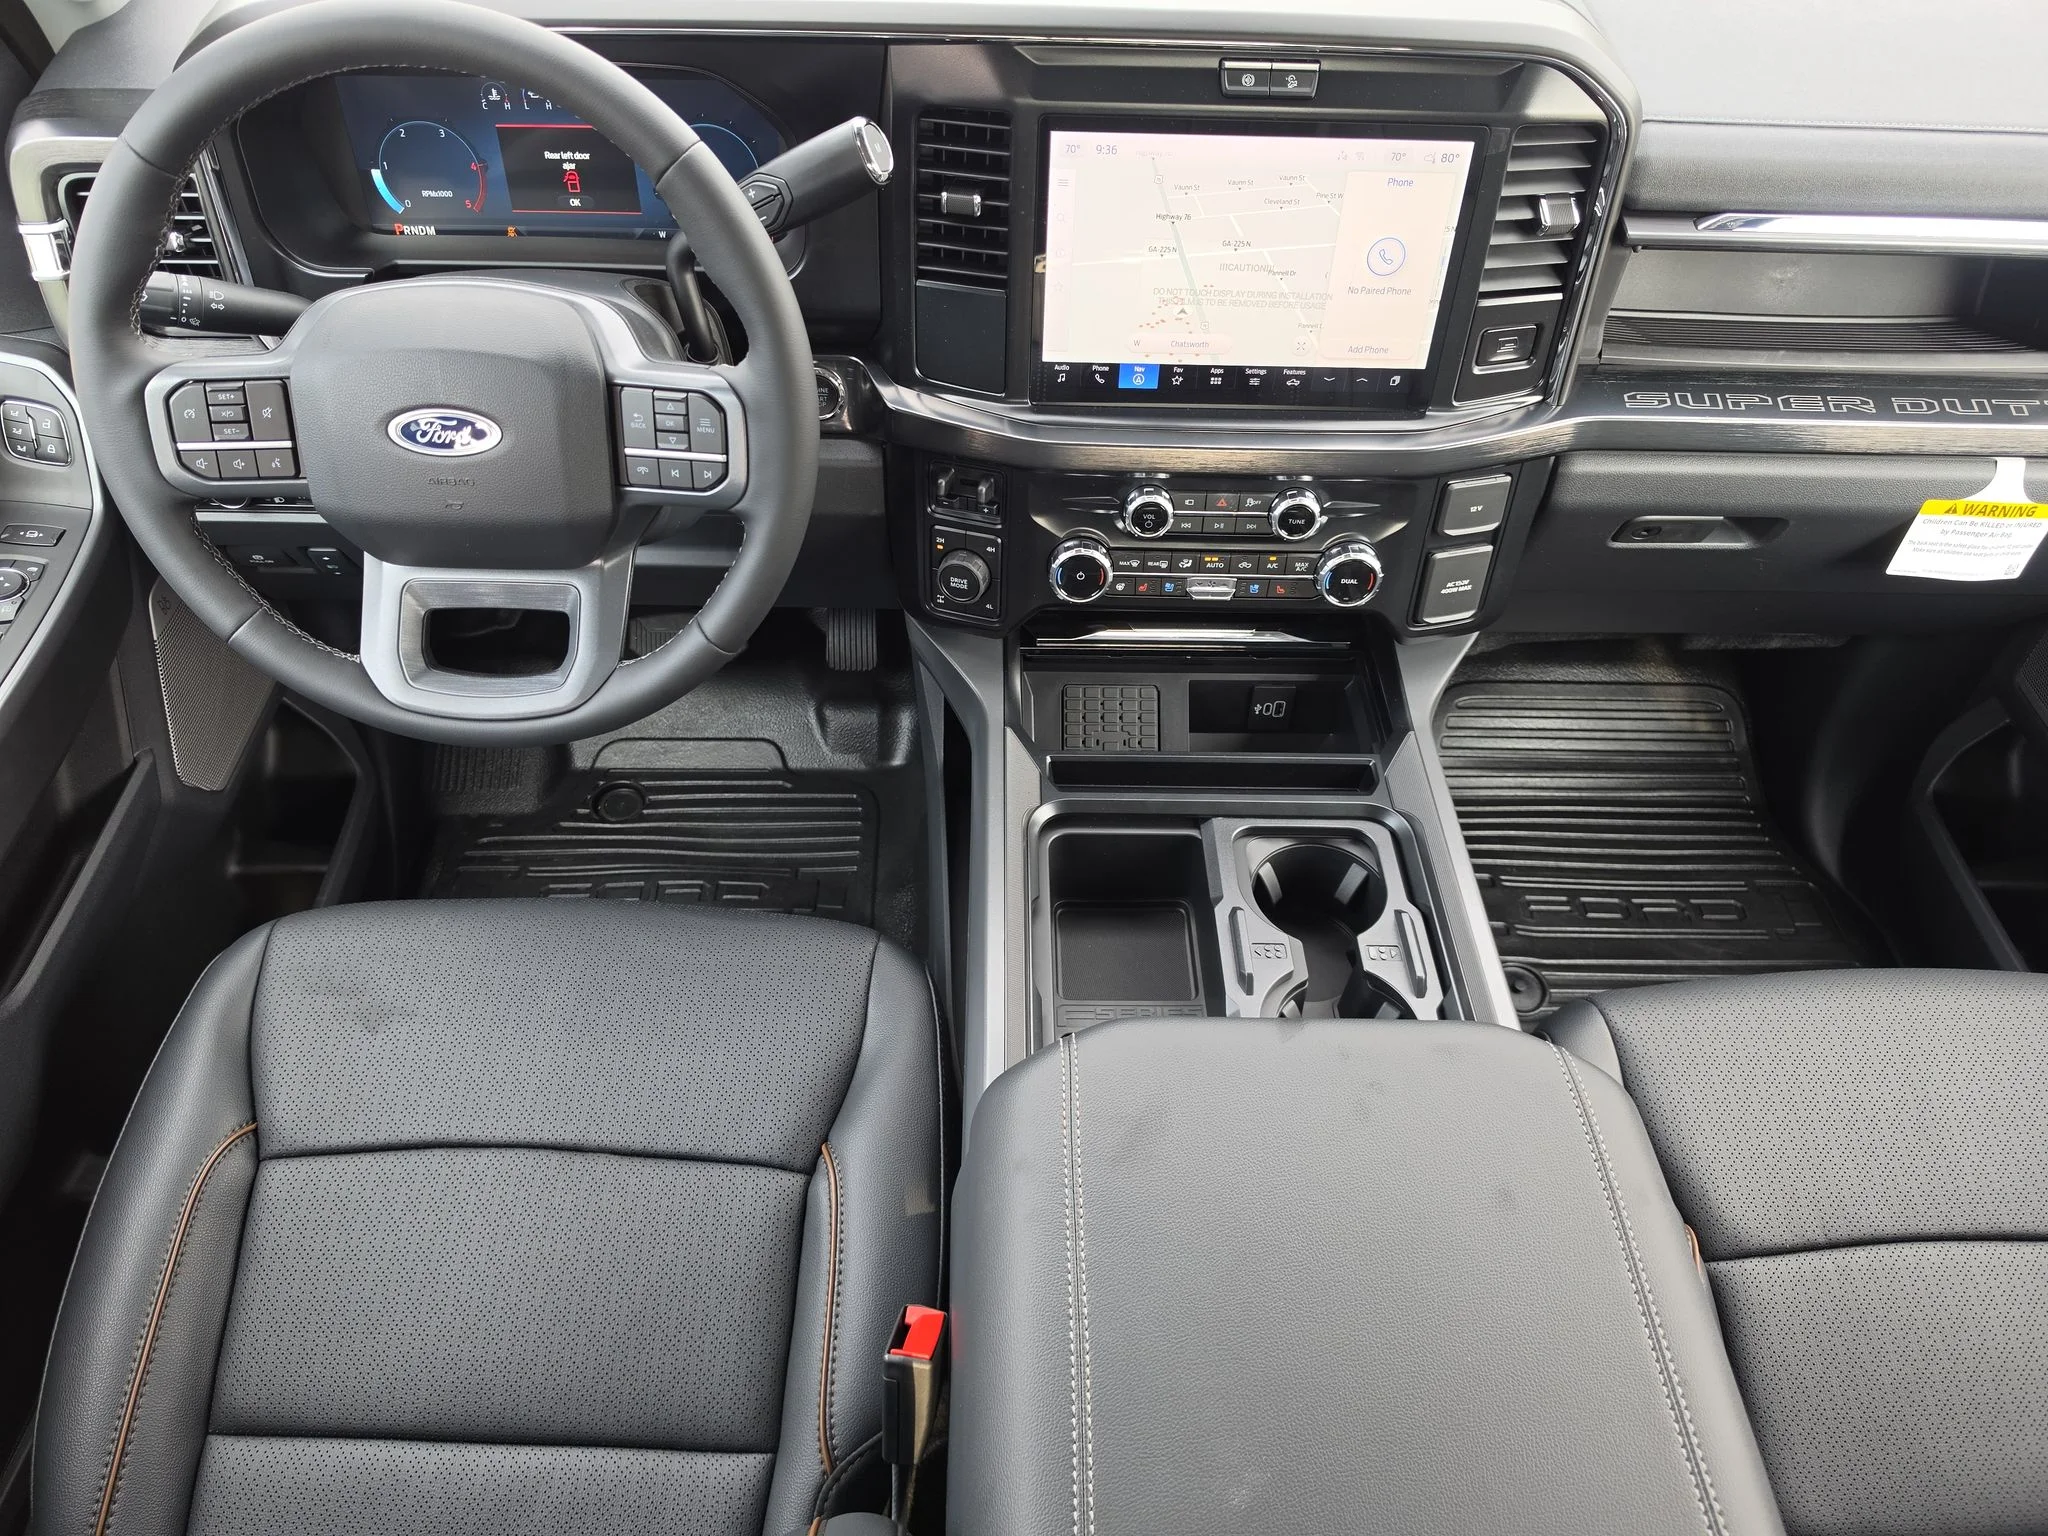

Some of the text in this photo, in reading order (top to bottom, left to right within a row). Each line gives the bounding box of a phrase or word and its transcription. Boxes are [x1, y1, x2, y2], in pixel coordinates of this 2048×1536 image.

[400, 128, 406, 138] 2
[439, 128, 445, 138] 3
[1096, 144, 1118, 155] 9:36
[544, 151, 590, 160] Rear left door
[1440, 152, 1460, 163] 80°
[562, 162, 576, 170] ajar
[1387, 178, 1414, 187] Phone
[569, 198, 581, 207] OK
[1156, 213, 1192, 222] Highway 76
[658, 230, 667, 239] W
[1214, 290, 1246, 298] DISPLAY
[1278, 292, 1332, 301] INSTALLATION
[1348, 286, 1412, 296] No Paired Phone
[1170, 340, 1209, 348] Chatsworth
[1348, 345, 1389, 354] Add Phone
[1623, 391, 2048, 417] SUPER DUT
[410, 416, 473, 444] Ford
[1962, 504, 2038, 518] WARNING
[1951, 529, 1986, 538] Passenger
[950, 577, 968, 585] DRIVE
[1522, 894, 1748, 921] FORD
